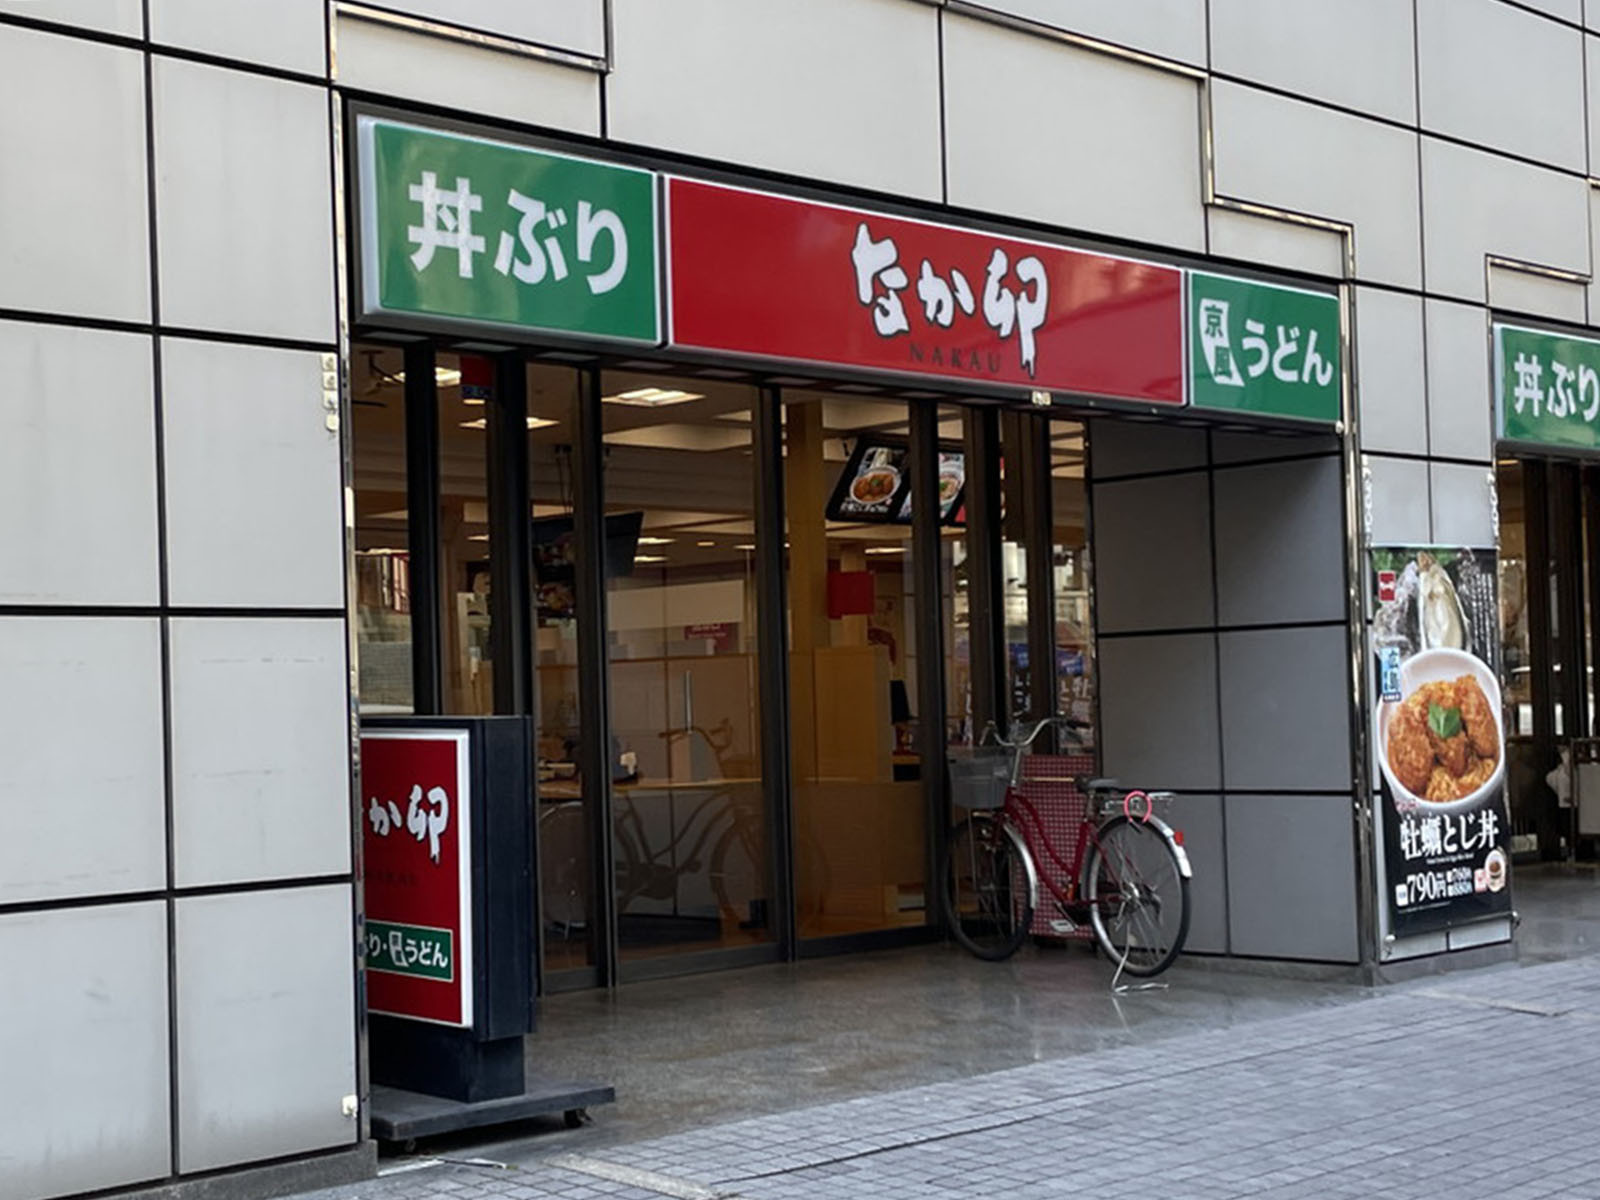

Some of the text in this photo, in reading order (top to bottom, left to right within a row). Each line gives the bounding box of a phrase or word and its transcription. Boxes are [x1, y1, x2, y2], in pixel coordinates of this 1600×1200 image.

[407, 170, 629, 295] 丼ぶり
[851, 222, 1049, 379] なか卯
[909, 342, 1002, 374] NAKAU
[1241, 318, 1334, 387] うどん
[1514, 352, 1600, 422] 丼ぶり
[363, 783, 449, 865] か卯
